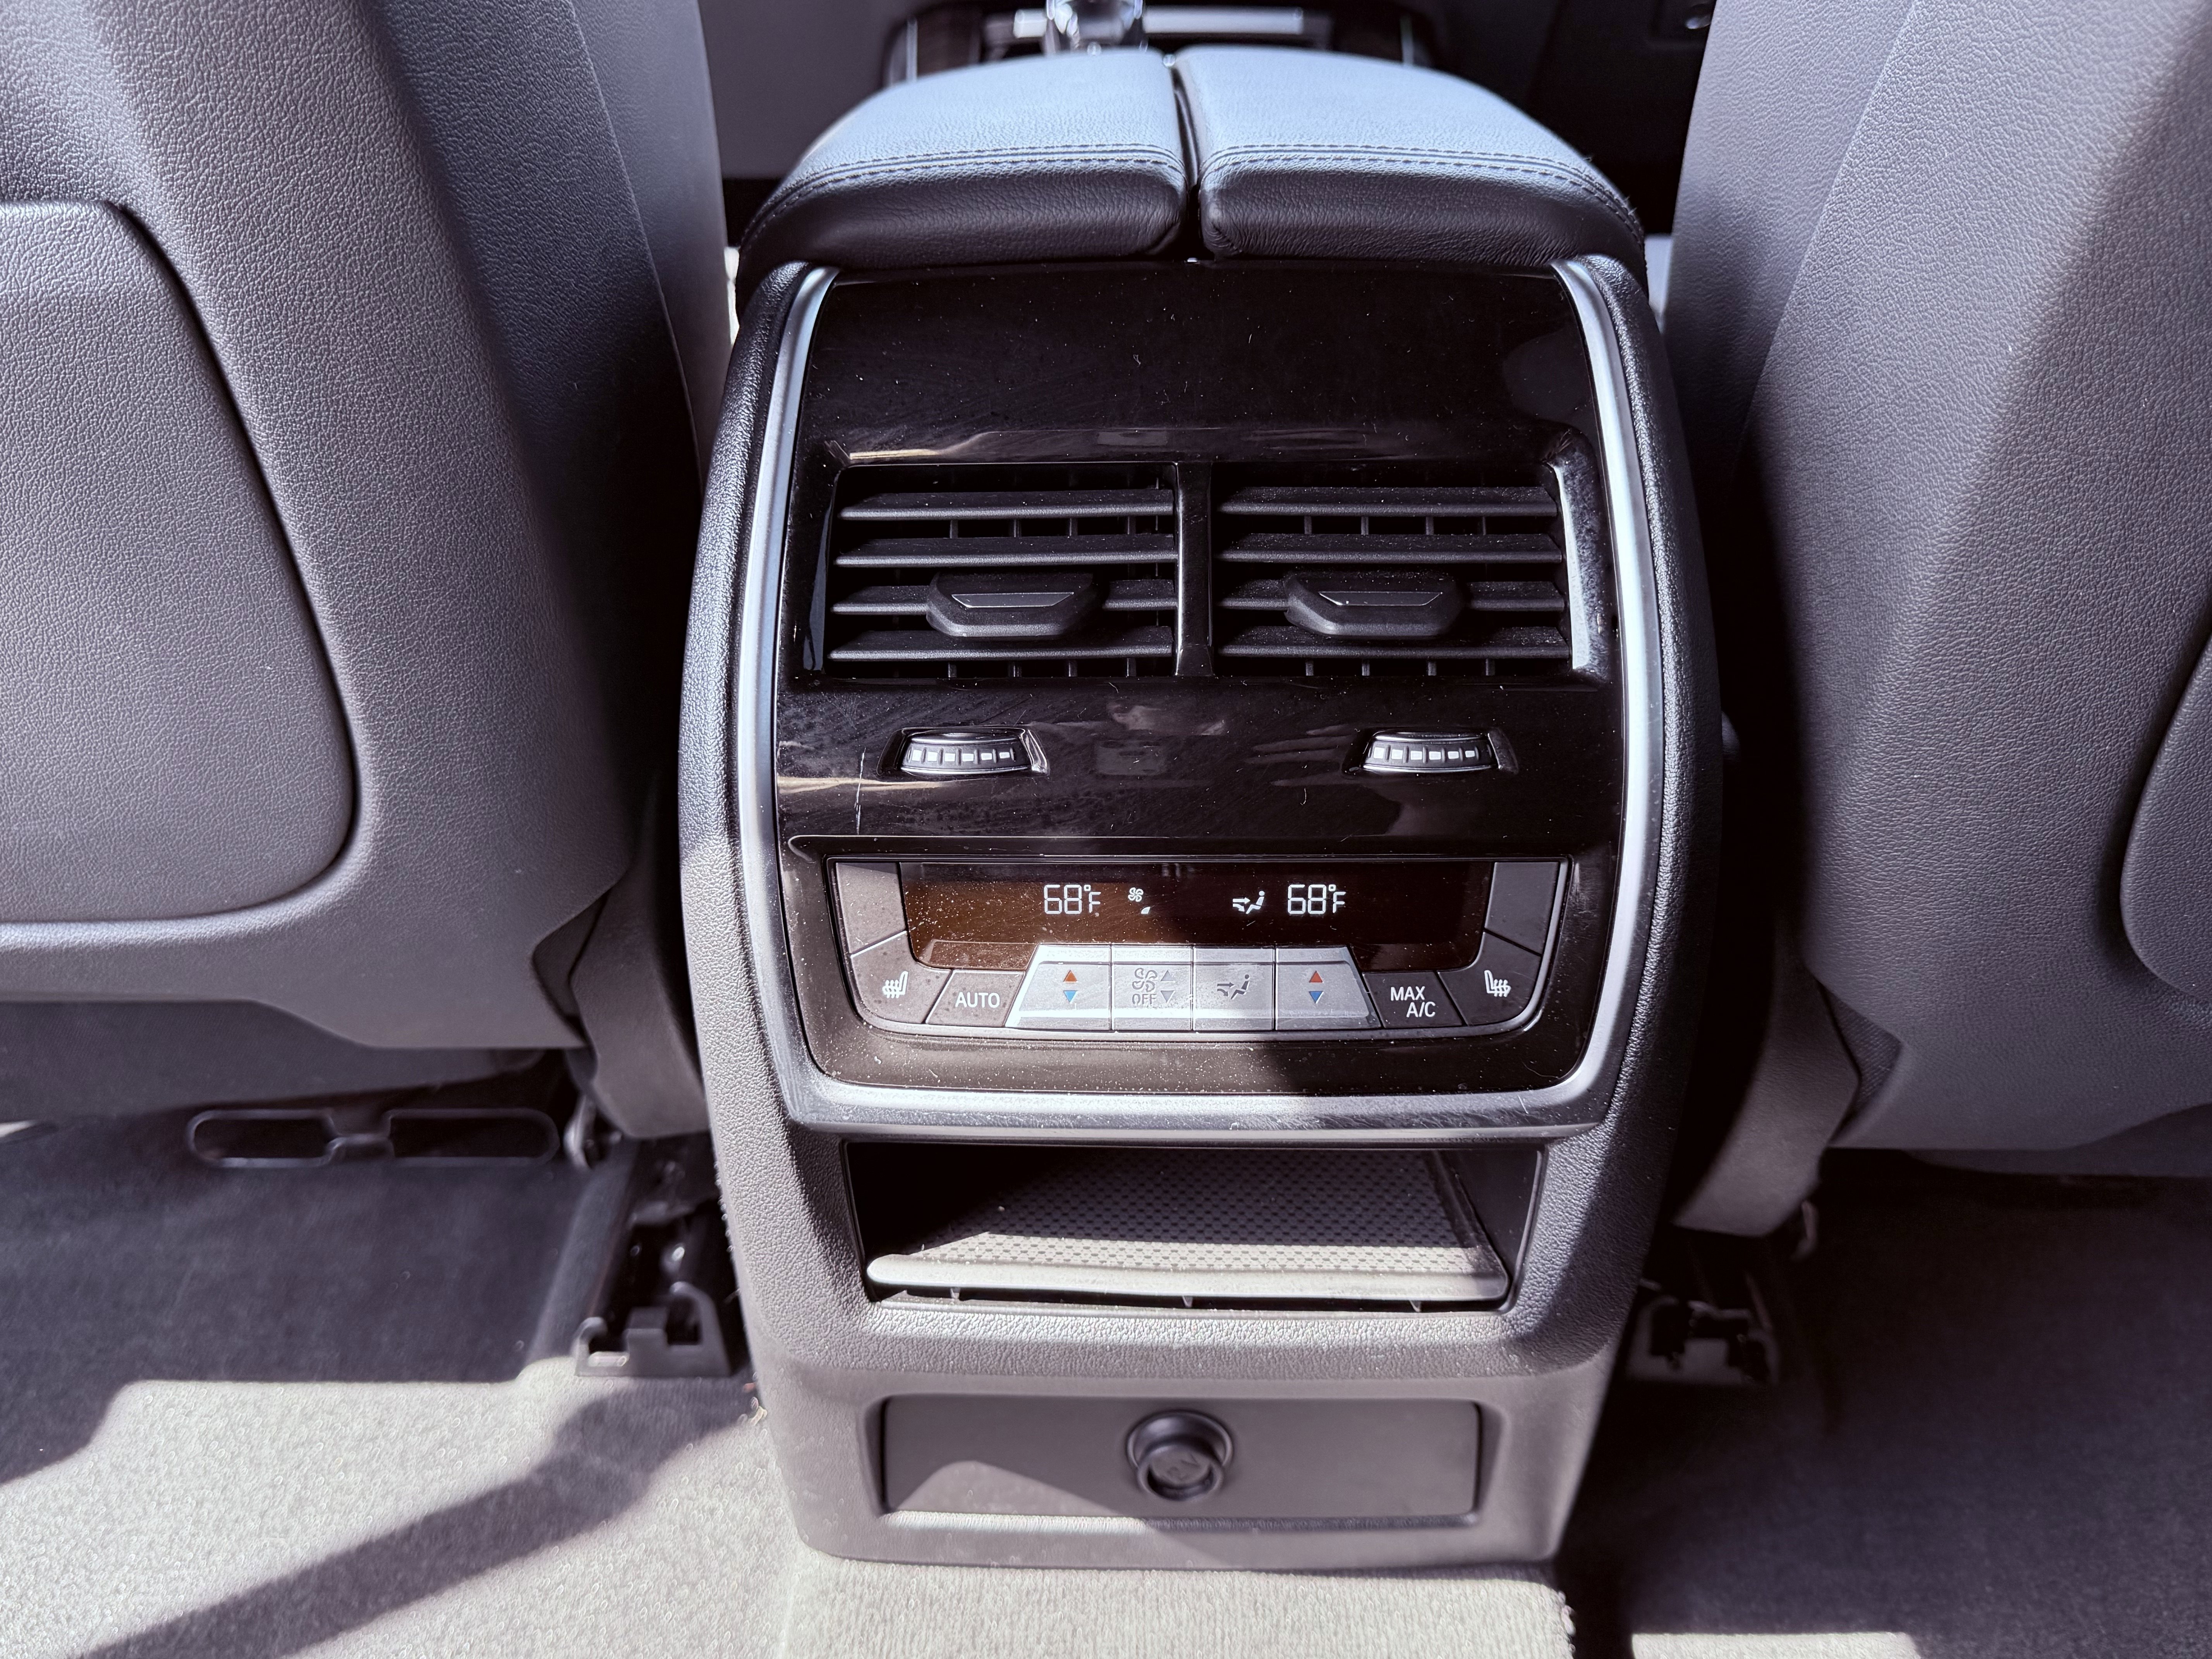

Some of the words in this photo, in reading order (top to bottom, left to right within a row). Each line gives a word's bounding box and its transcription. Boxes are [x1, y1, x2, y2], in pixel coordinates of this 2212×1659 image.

[1044, 884, 1102, 914] 68°F
[1288, 884, 1346, 914] 68°F
[955, 992, 1001, 1008] AUTO
[1132, 994, 1157, 1005] OFF
[1391, 986, 1425, 1001] MAX
[1407, 1002, 1436, 1018] A/C
